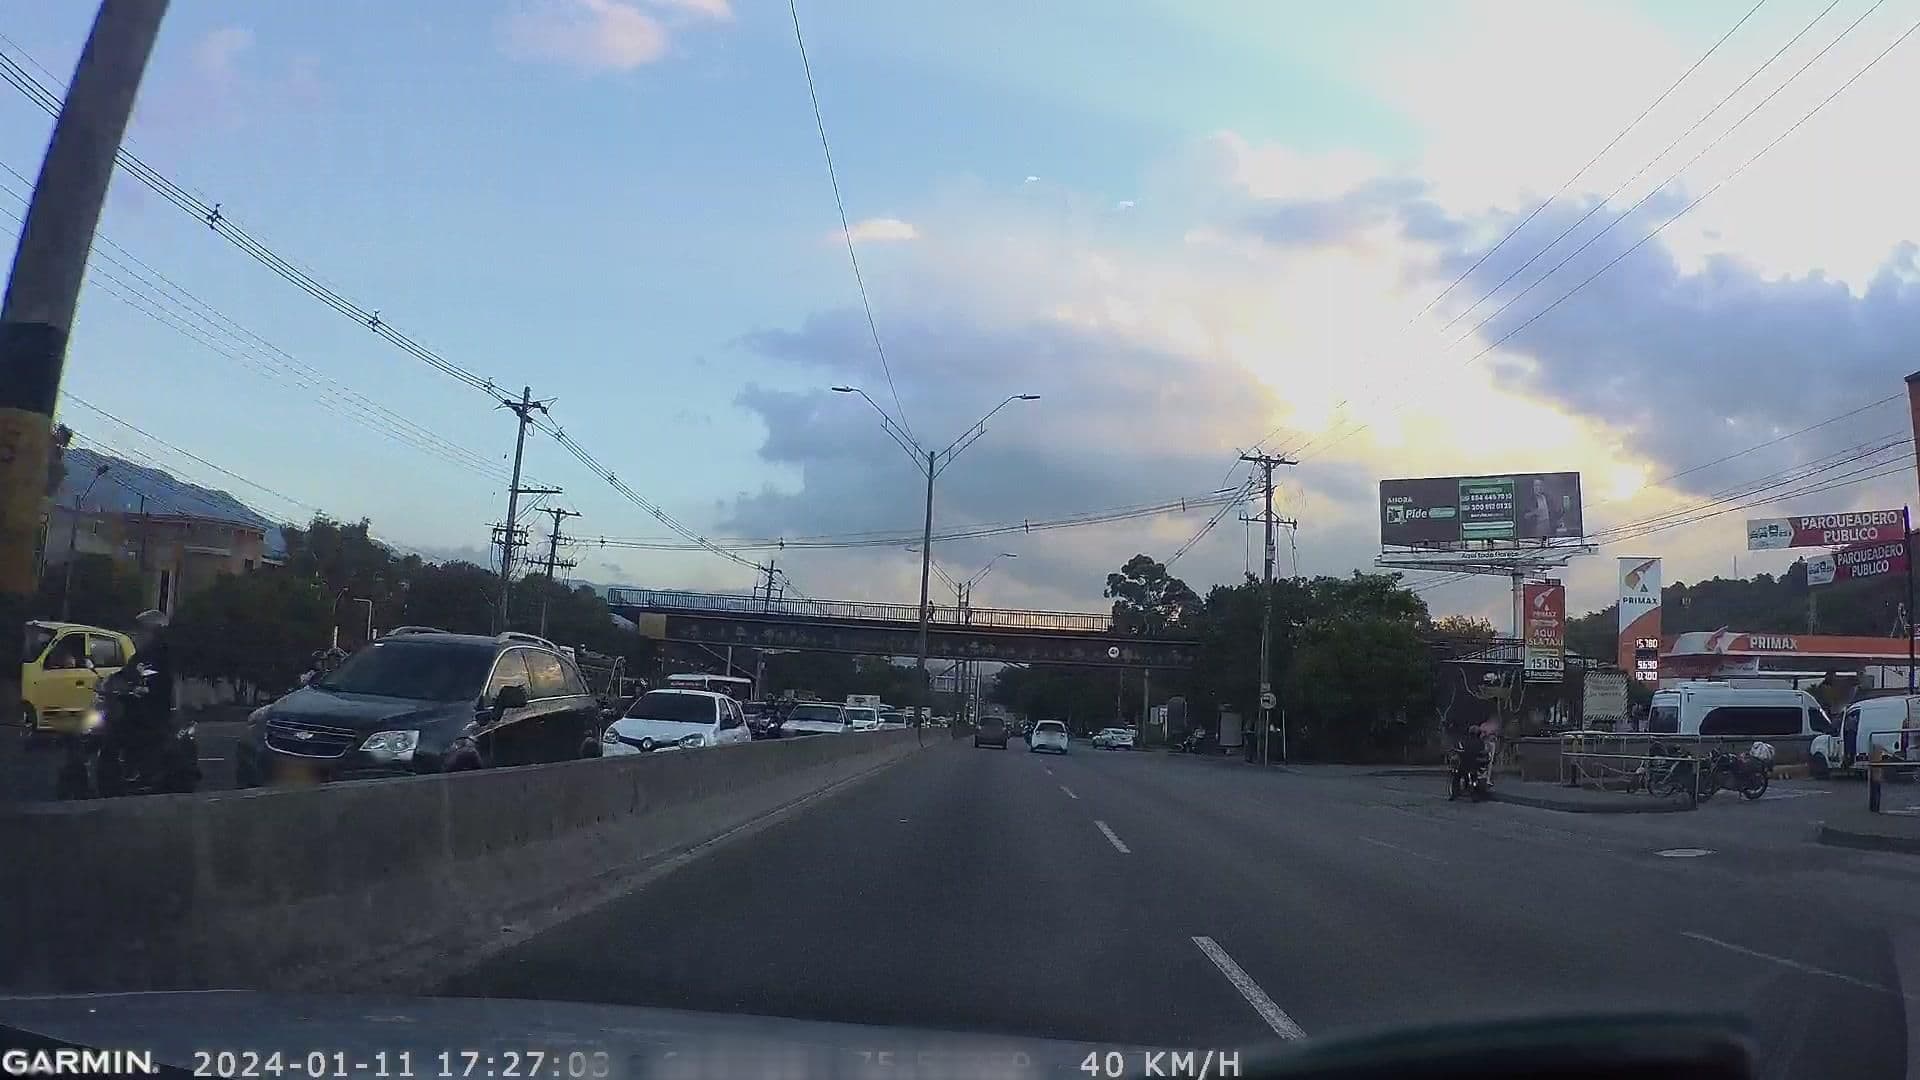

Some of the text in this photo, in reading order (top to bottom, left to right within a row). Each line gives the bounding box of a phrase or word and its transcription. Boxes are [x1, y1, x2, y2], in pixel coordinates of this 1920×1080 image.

[1801, 511, 1898, 530] PARQUEADERO
[1824, 527, 1878, 542] PUBLICO
[1837, 543, 1904, 566] PARQUEADERO
[1851, 560, 1889, 577] PUBLICO
[1622, 596, 1658, 605] PRIMAX
[1750, 636, 1798, 650] PRIMAX
